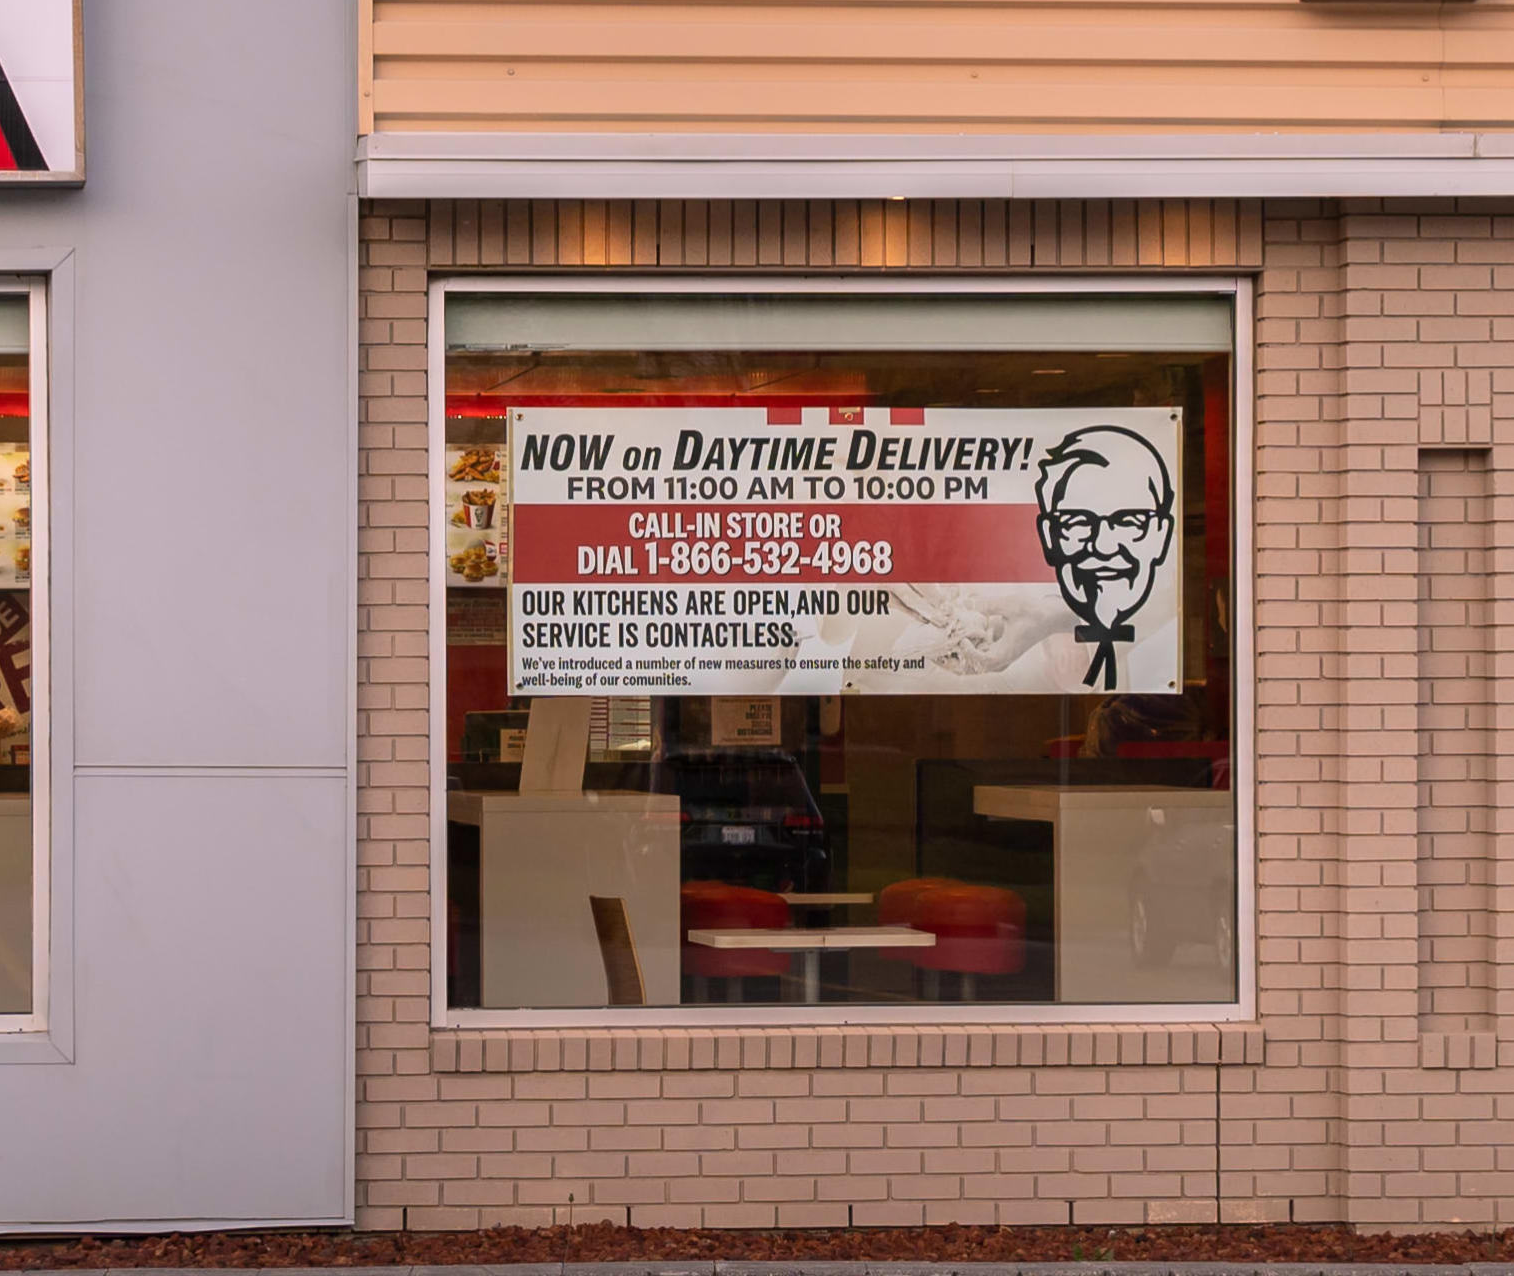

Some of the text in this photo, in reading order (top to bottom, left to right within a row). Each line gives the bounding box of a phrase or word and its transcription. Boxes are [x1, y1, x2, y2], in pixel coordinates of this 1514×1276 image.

[520, 429, 1034, 471] NOW on DAYTIME DELIVERY!
[567, 476, 989, 500] FROM 11:00 AM TO 10:00 PM
[628, 512, 842, 539] CALL-IN STORE OR
[577, 540, 893, 575] DIAL 1-866-532-4968
[521, 590, 565, 616] OUR
[573, 590, 678, 616] KITCHENS
[685, 590, 726, 616] ARE
[847, 590, 890, 615] OUR
[522, 622, 799, 648] SERVICE IS CONTACTLESS.
[522, 656, 925, 672] We've introduced a number of new measures to ensure the safety and
[522, 673, 692, 688] well-being of our comunities.
